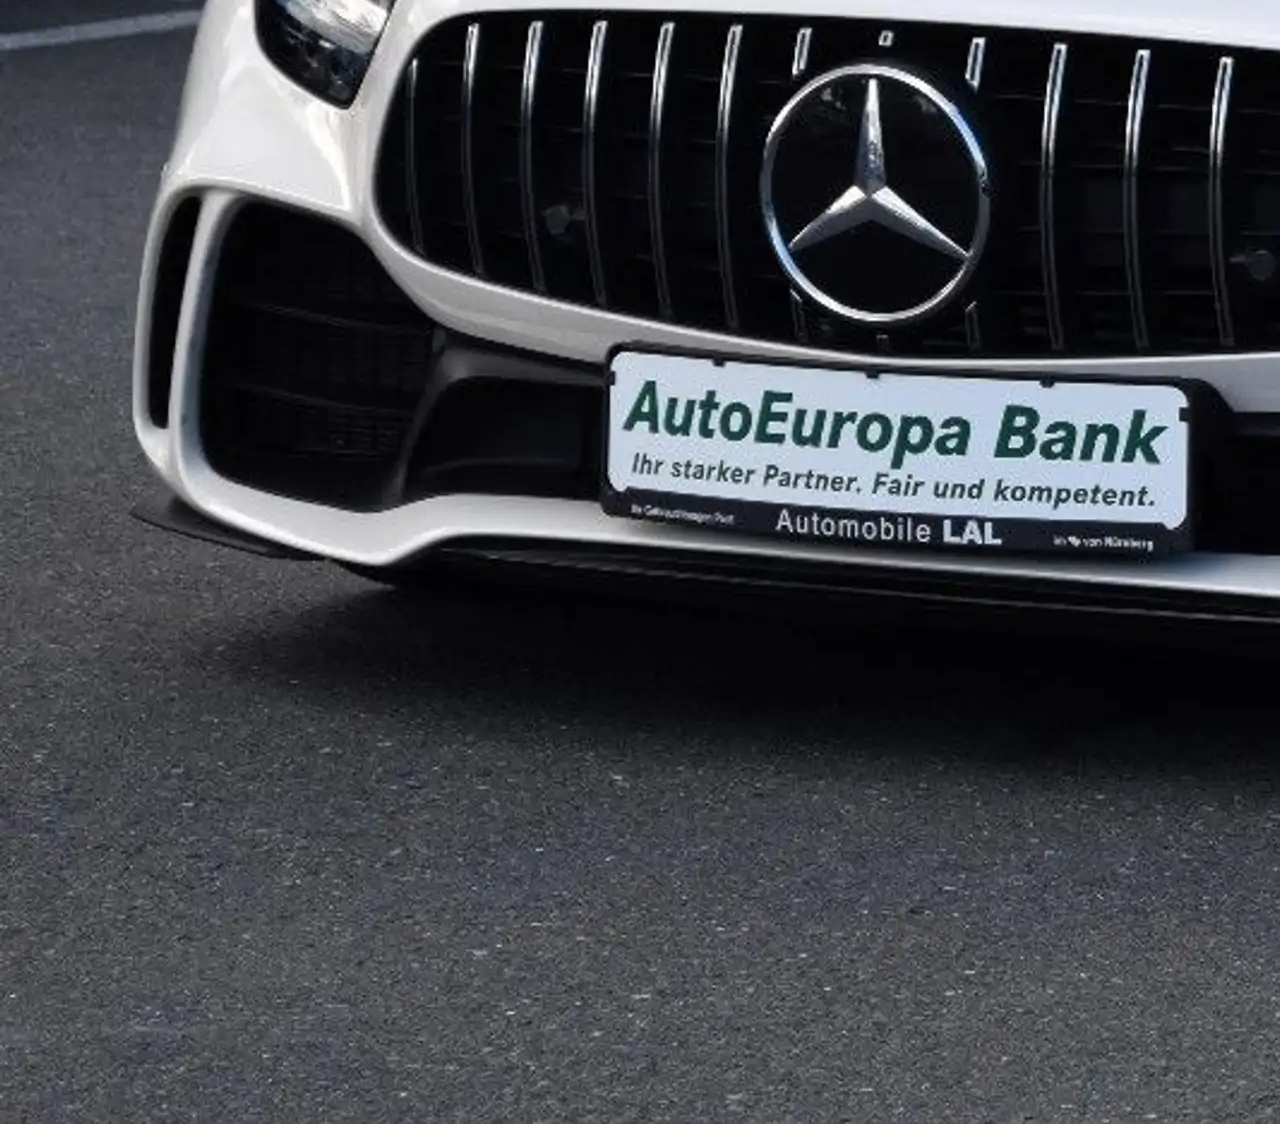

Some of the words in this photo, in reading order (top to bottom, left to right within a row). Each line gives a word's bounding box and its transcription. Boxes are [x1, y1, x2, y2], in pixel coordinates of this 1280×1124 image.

[622, 379, 972, 471] AutoEuropa
[993, 404, 1169, 465] Bank
[631, 452, 665, 476] Ihr
[669, 459, 757, 485] starker
[762, 463, 864, 494] Partner.
[871, 471, 927, 498] Fair
[932, 478, 987, 501] und
[993, 478, 1157, 511] kompetent.
[775, 508, 932, 544] Automobile
[942, 519, 1004, 545] LAL
